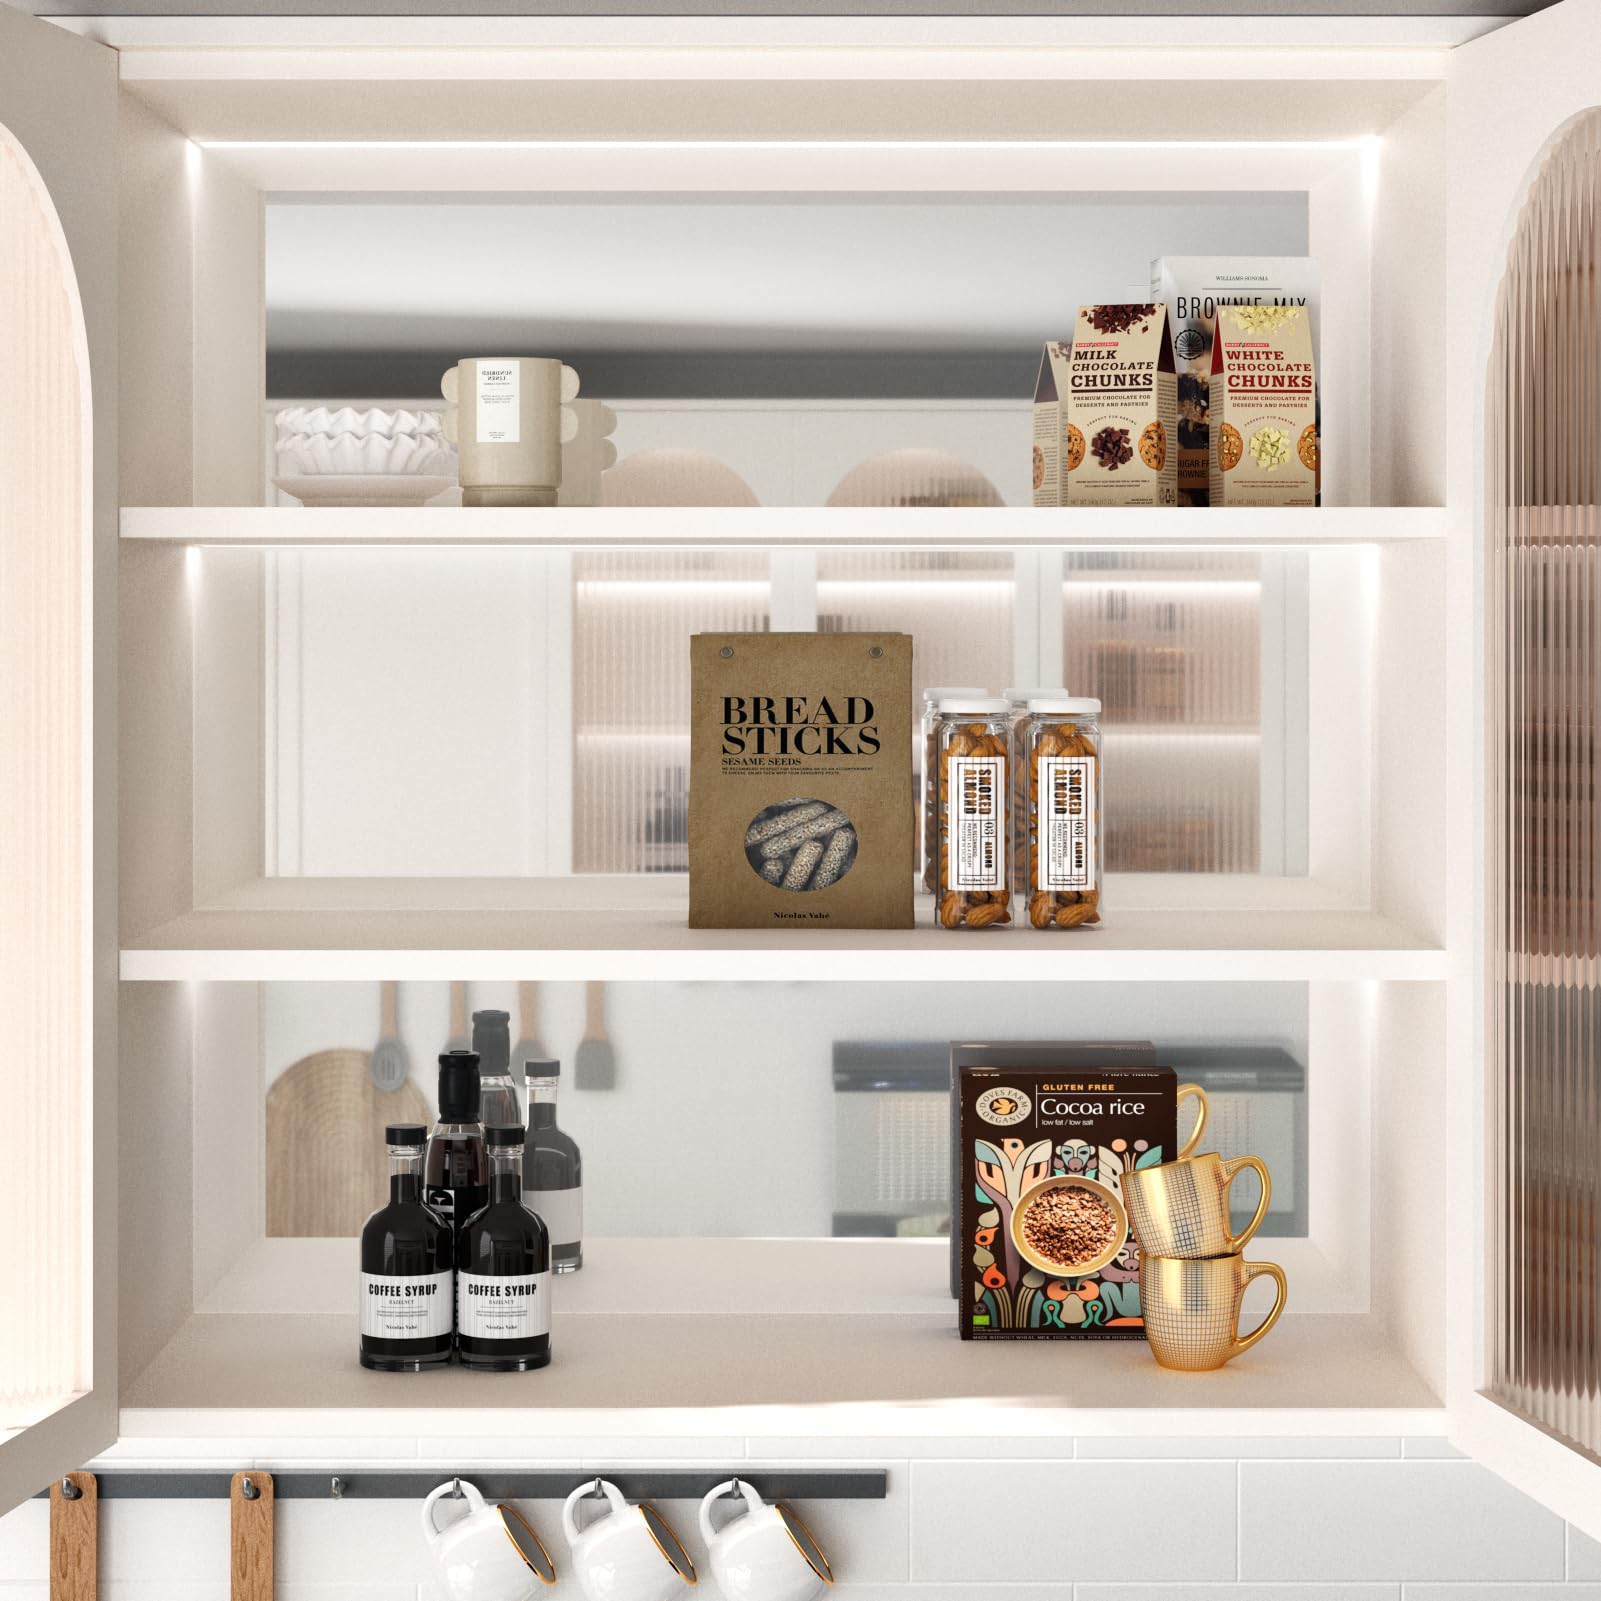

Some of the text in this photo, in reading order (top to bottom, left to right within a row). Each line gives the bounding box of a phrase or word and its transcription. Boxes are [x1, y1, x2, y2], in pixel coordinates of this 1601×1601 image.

[1074, 350, 1117, 360] MILK
[1225, 351, 1284, 360] WHITE
[1072, 362, 1154, 371] CHOCOLATE
[1227, 363, 1312, 371] CHOCOLATE
[1071, 373, 1153, 387] CHUNKS
[1228, 375, 1312, 387] CHUNKS
[1178, 459, 1200, 468] UGAR
[720, 696, 875, 725] BREAD
[722, 726, 881, 755] STICKS
[721, 757, 802, 766] SESAME SEEDS
[963, 769, 977, 815] ALMOND
[978, 769, 992, 815] SMOKED
[1053, 769, 1067, 815] ALMOND
[1068, 769, 1082, 815] SMOKED
[983, 821, 994, 835] 03
[1074, 821, 1085, 835] 03
[984, 841, 992, 869] ALMOND
[1074, 841, 1083, 869] ALMOND
[980, 1089, 1028, 1108] DOVES FARM
[1040, 1098, 1145, 1115] Cocoa rice
[982, 1110, 1026, 1124] ORGANIC
[369, 1284, 437, 1296] COFFEE SYRUP
[468, 1284, 537, 1296] COFFEE SYRUP
